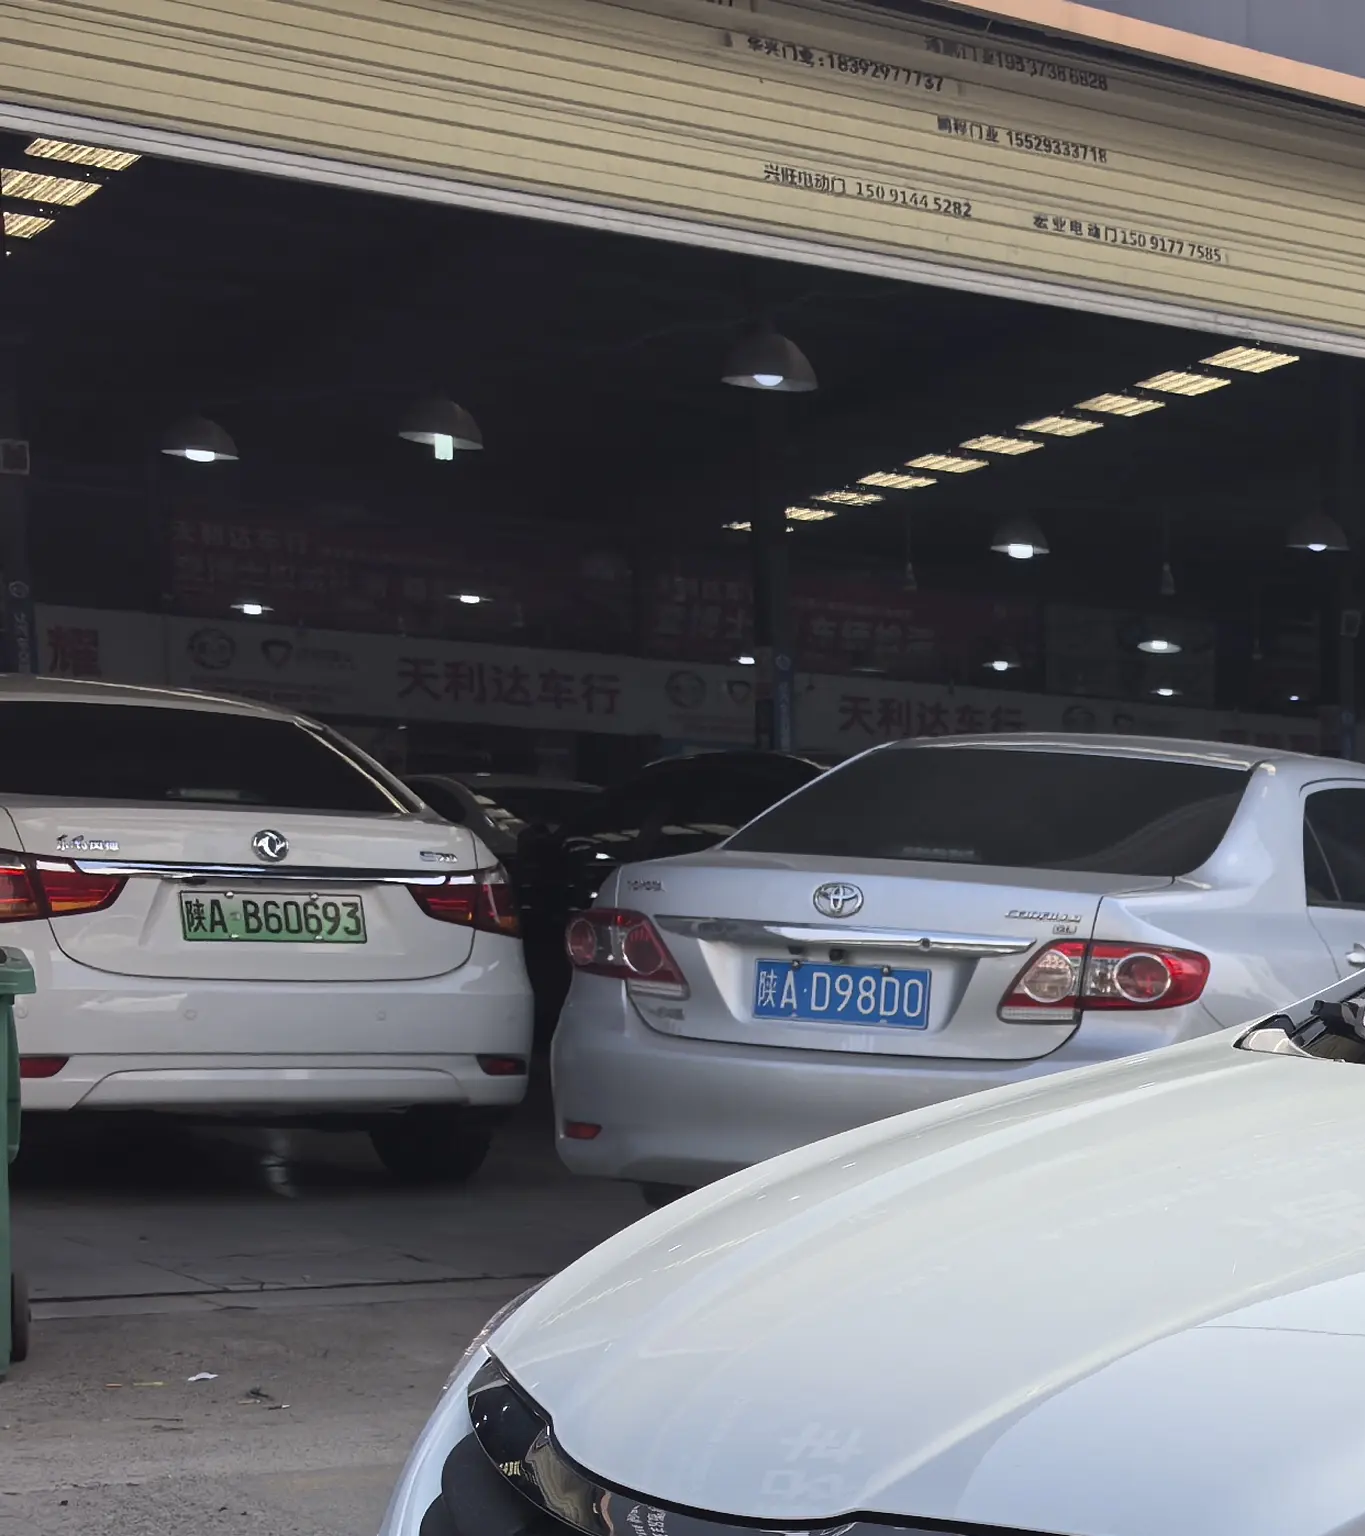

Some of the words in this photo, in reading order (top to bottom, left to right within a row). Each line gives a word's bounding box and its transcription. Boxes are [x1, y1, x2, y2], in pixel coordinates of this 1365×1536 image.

[856, 181, 885, 198] 150
[933, 197, 972, 217] 5282
[1150, 235, 1185, 254] 9177
[1188, 243, 1223, 262] 7585
[398, 655, 621, 715] 天利达车行
[242, 900, 363, 936] B60693
